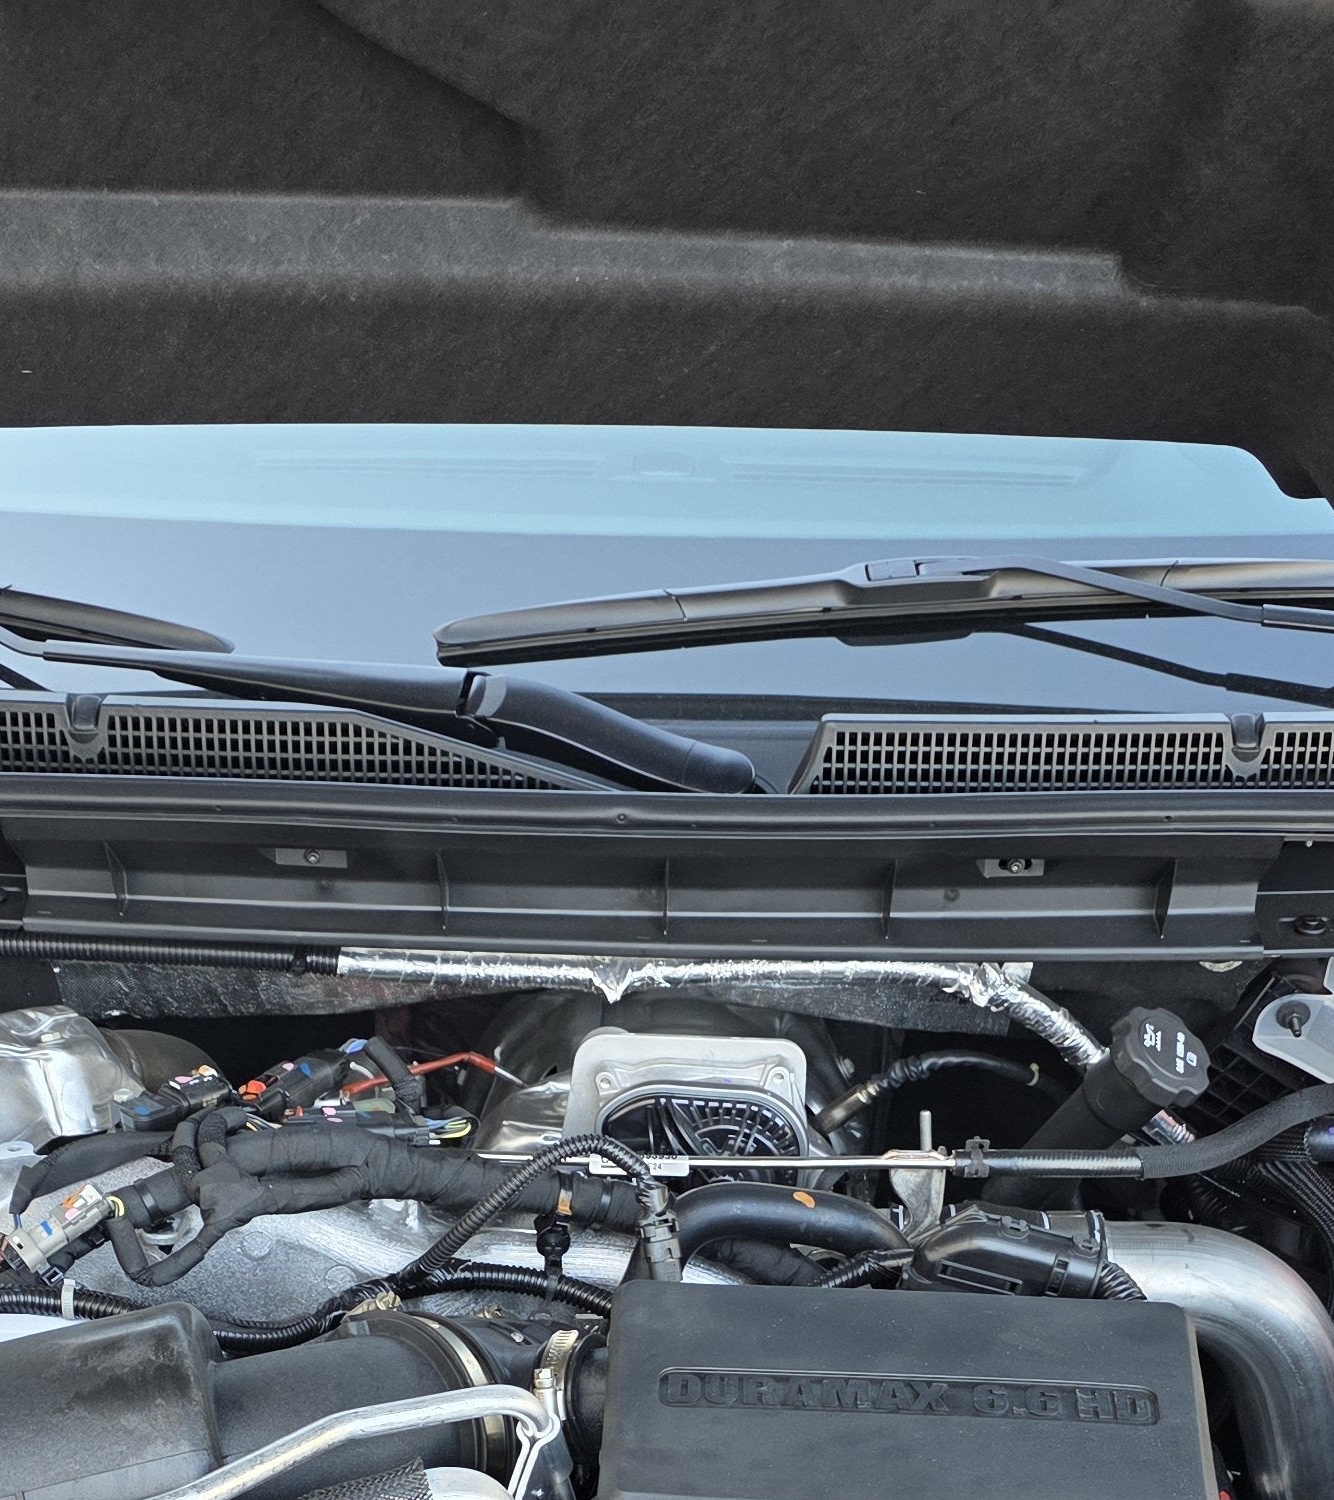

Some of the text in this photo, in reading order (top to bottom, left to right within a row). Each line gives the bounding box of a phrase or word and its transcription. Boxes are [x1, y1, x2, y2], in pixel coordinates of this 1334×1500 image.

[667, 1374, 1152, 1420] DURAMAX 6.6 HD
